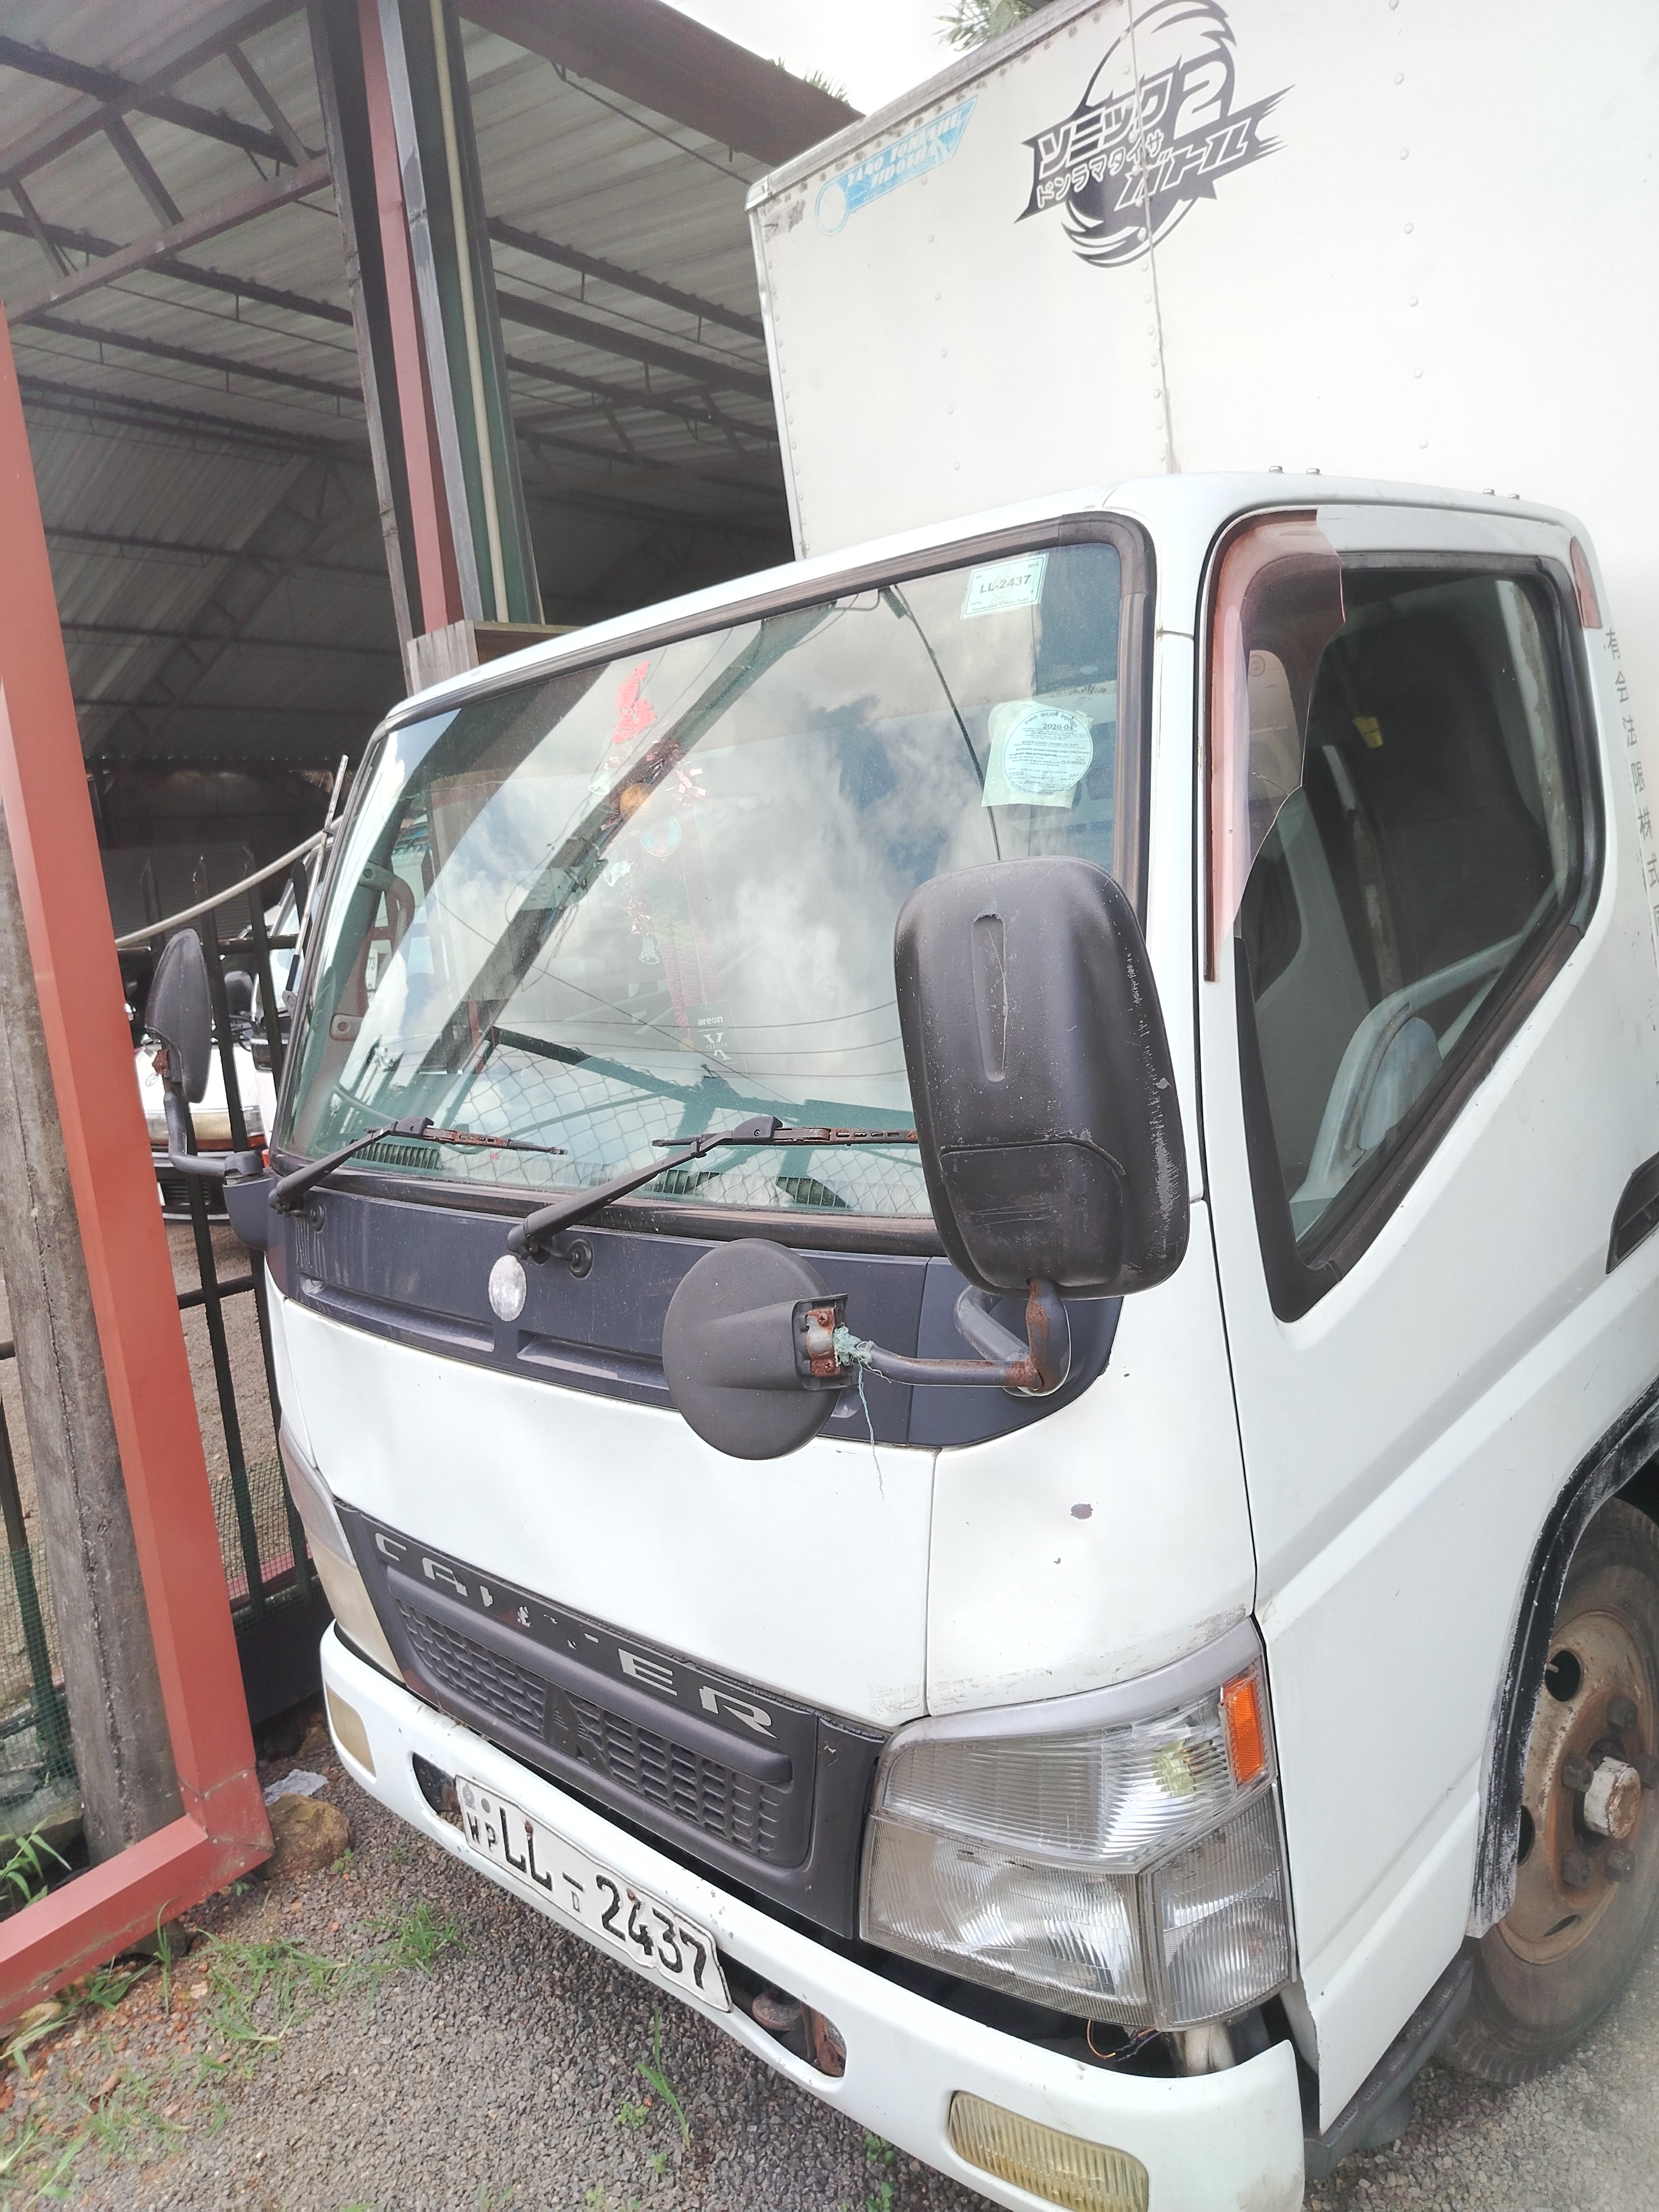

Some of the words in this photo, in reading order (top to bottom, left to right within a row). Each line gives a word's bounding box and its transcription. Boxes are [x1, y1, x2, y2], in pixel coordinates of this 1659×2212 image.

[979, 574, 1032, 594] LL-2437
[1043, 723, 1073, 731] 2026-04
[697, 1016, 724, 1026] areon
[374, 1531, 778, 1739] CAER
